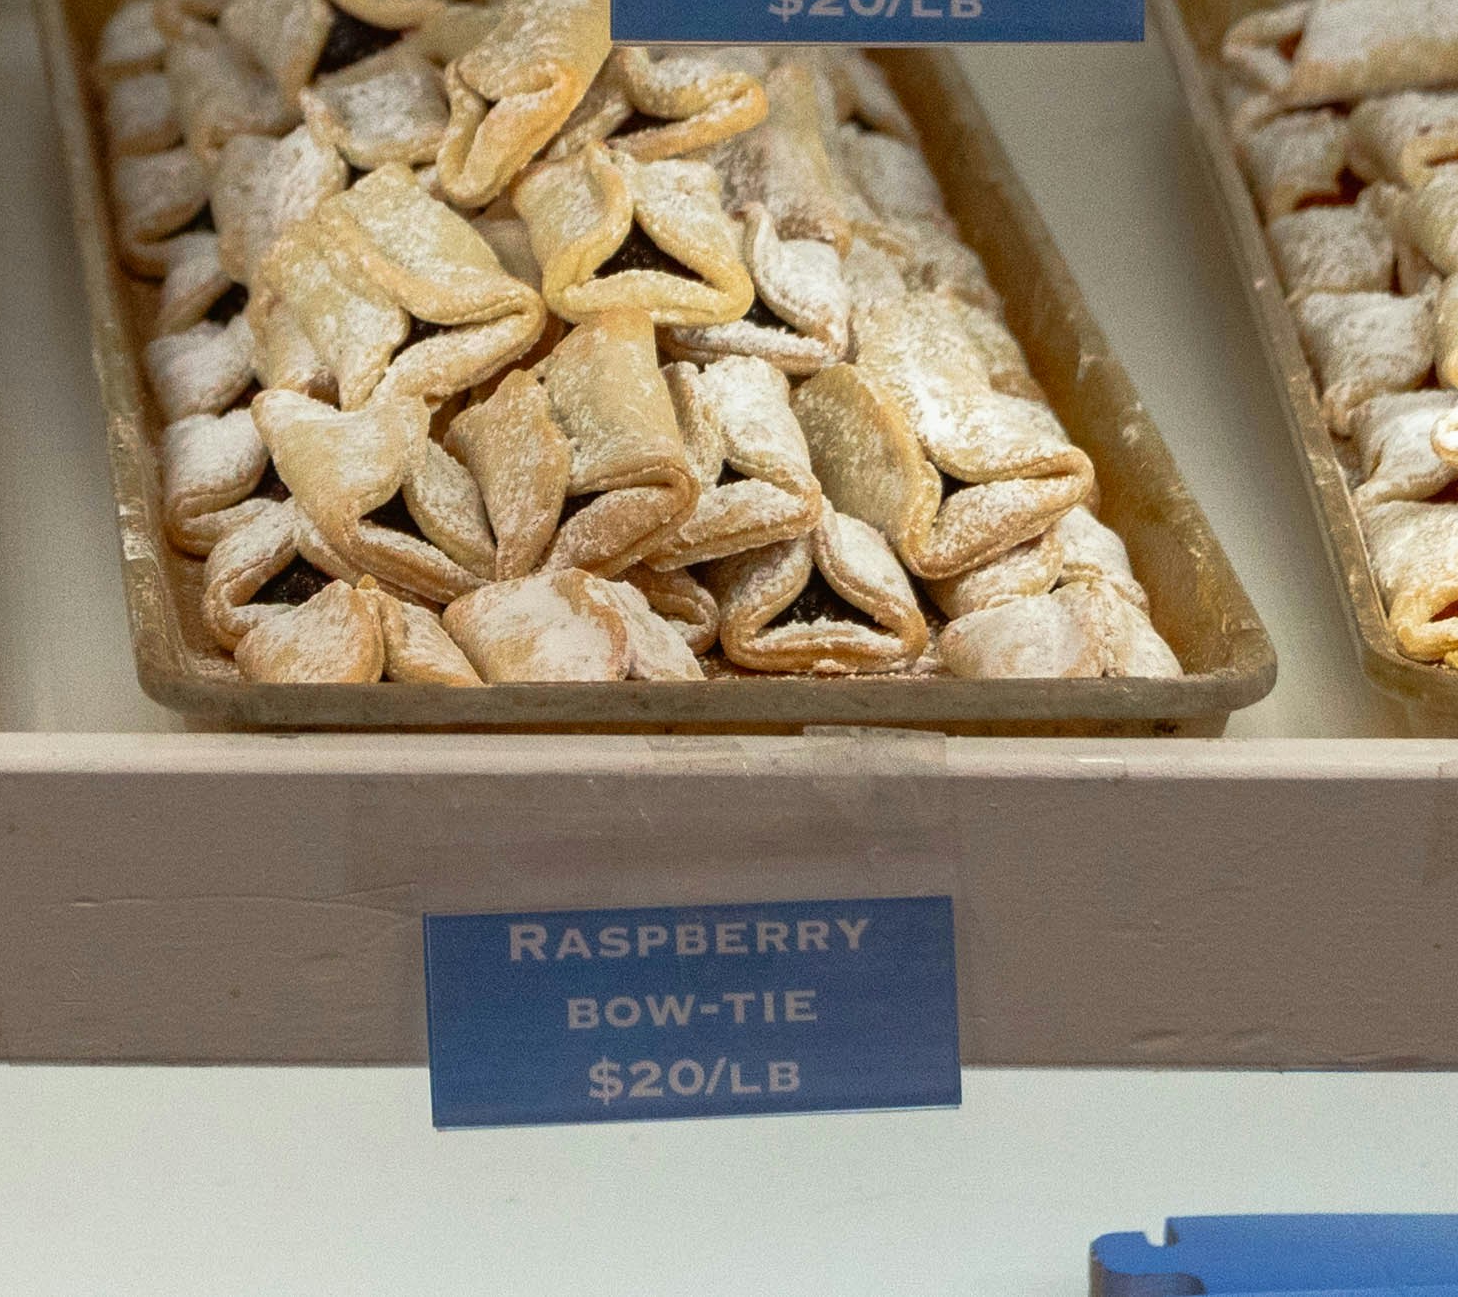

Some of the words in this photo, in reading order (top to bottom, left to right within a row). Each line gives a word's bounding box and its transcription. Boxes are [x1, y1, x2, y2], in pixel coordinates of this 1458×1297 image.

[509, 918, 869, 961] RASPBERRY
[567, 989, 818, 1030] BOW-TIE
[588, 1057, 801, 1105] $20/LB
